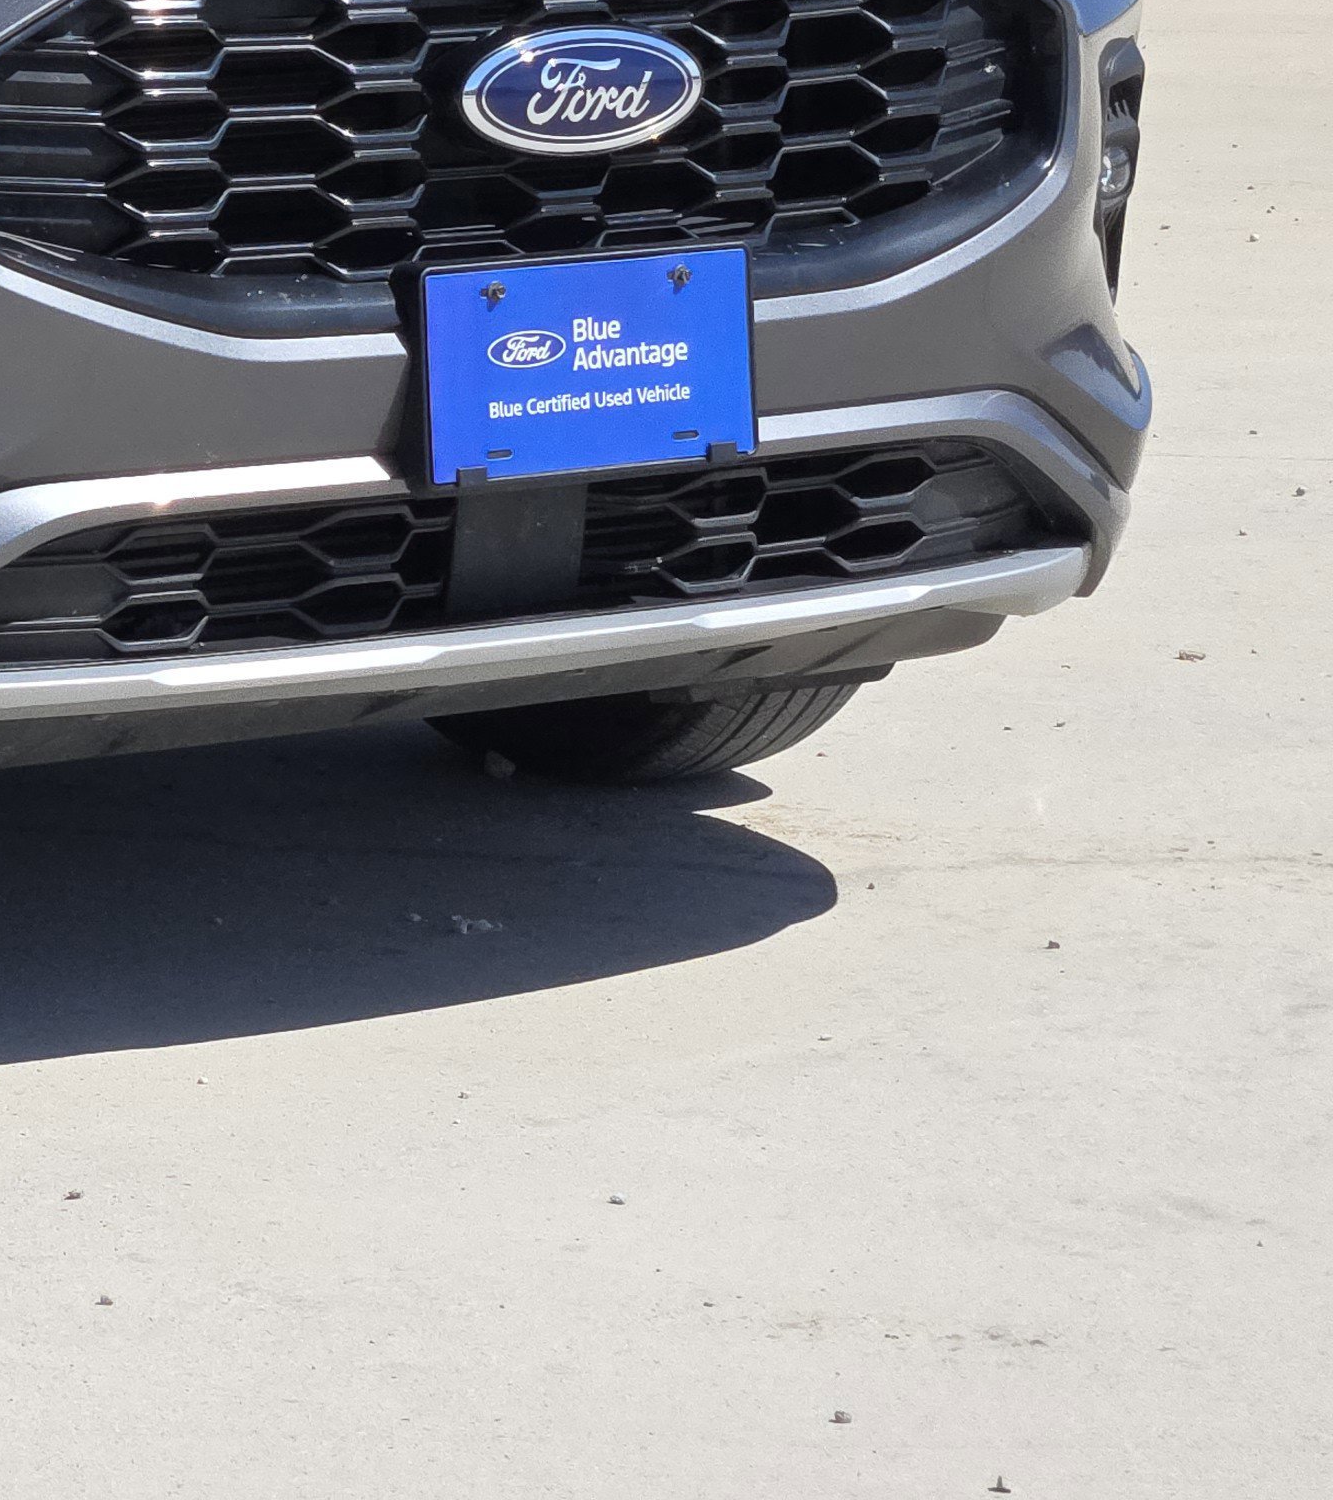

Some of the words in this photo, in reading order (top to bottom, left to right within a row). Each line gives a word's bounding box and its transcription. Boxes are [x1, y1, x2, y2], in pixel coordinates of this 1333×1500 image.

[526, 57, 653, 127] Ford
[572, 316, 621, 343] Blue
[502, 335, 552, 363] Ford
[572, 341, 689, 372] Advantage
[489, 400, 523, 419] Blue
[526, 393, 590, 415] Certified
[594, 388, 633, 408] Used
[636, 383, 691, 404] Vehicle
